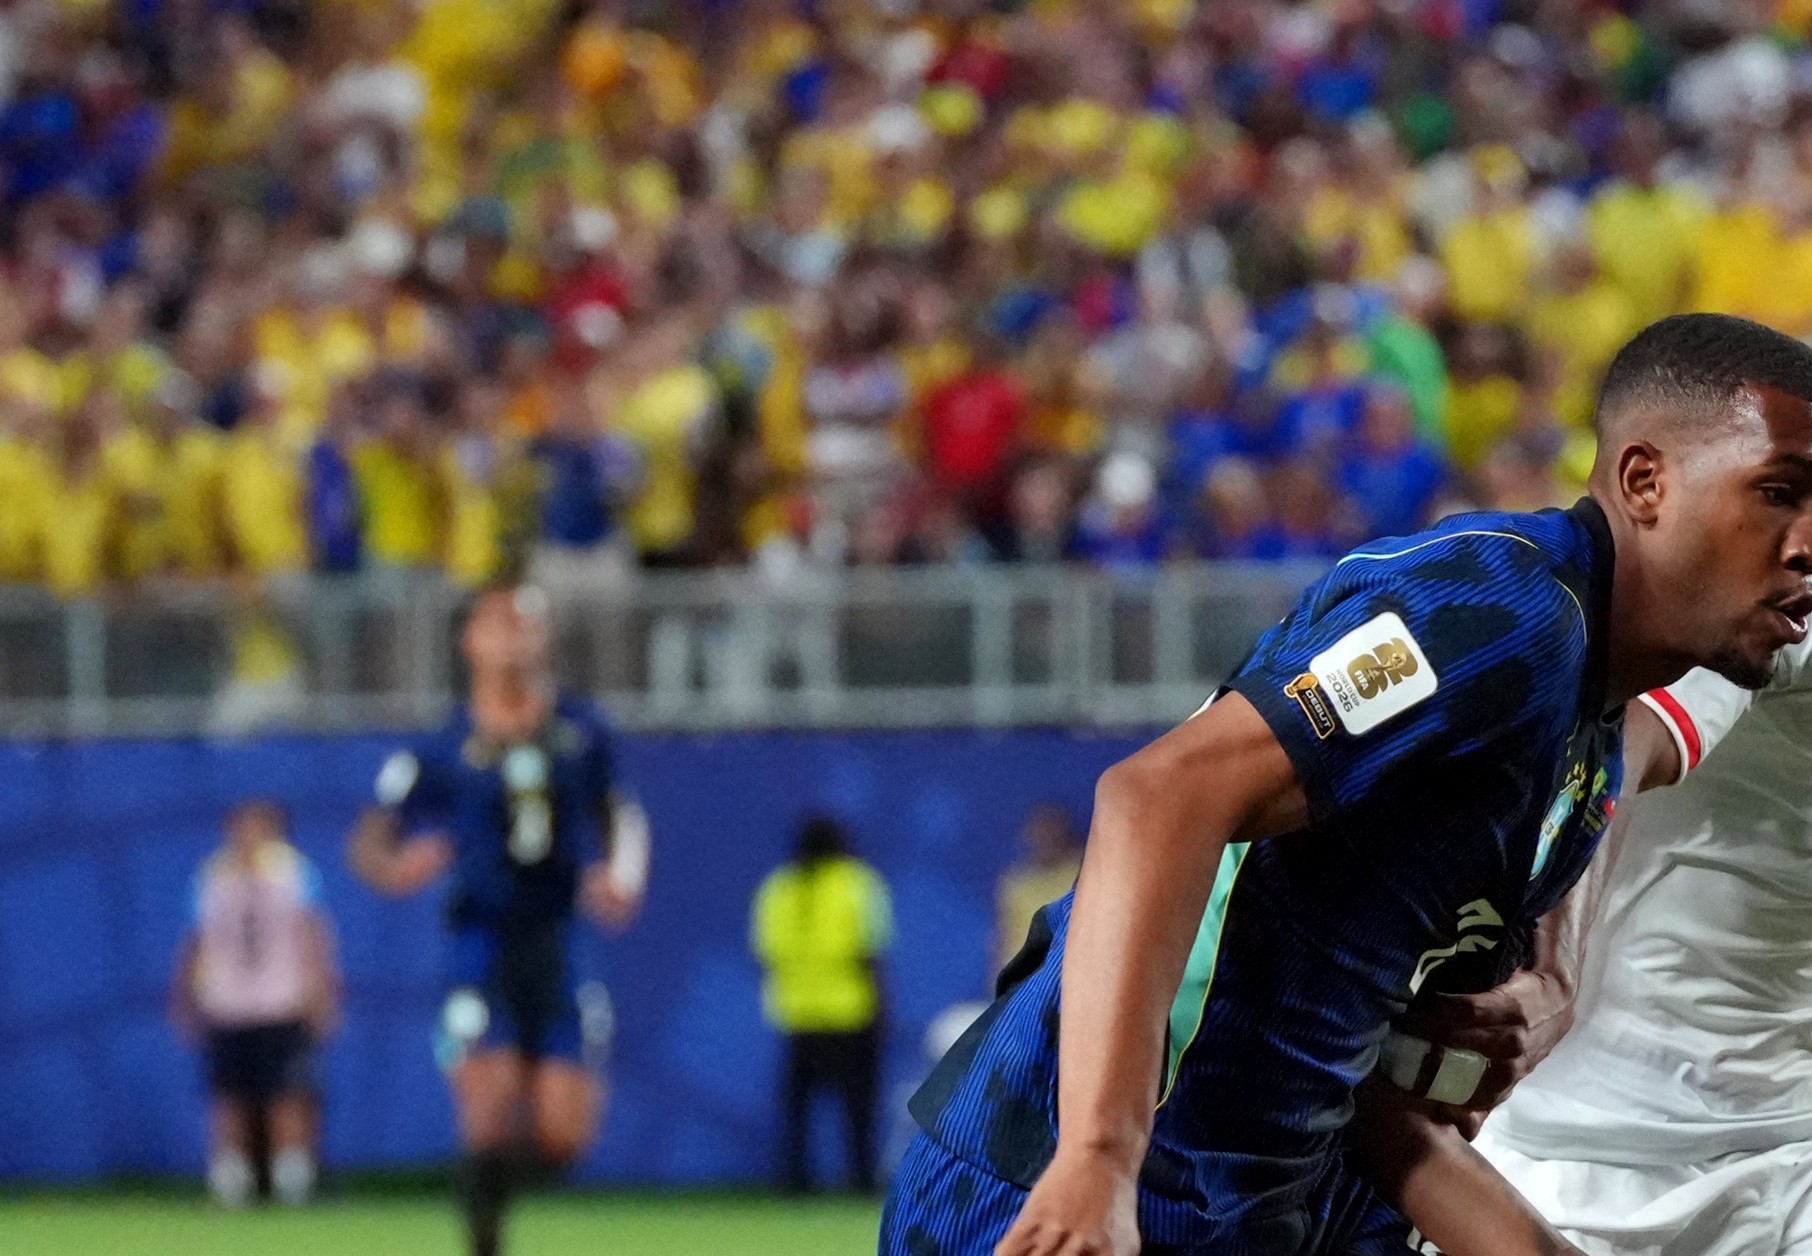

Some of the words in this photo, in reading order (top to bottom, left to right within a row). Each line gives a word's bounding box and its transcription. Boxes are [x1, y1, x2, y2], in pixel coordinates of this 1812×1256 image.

[1326, 672, 1354, 713] 2026
[1336, 669, 1353, 693] WORLD
[1350, 692, 1360, 707] CUP
[1354, 670, 1369, 691] FIFA
[1305, 689, 1331, 728] DEBUT
